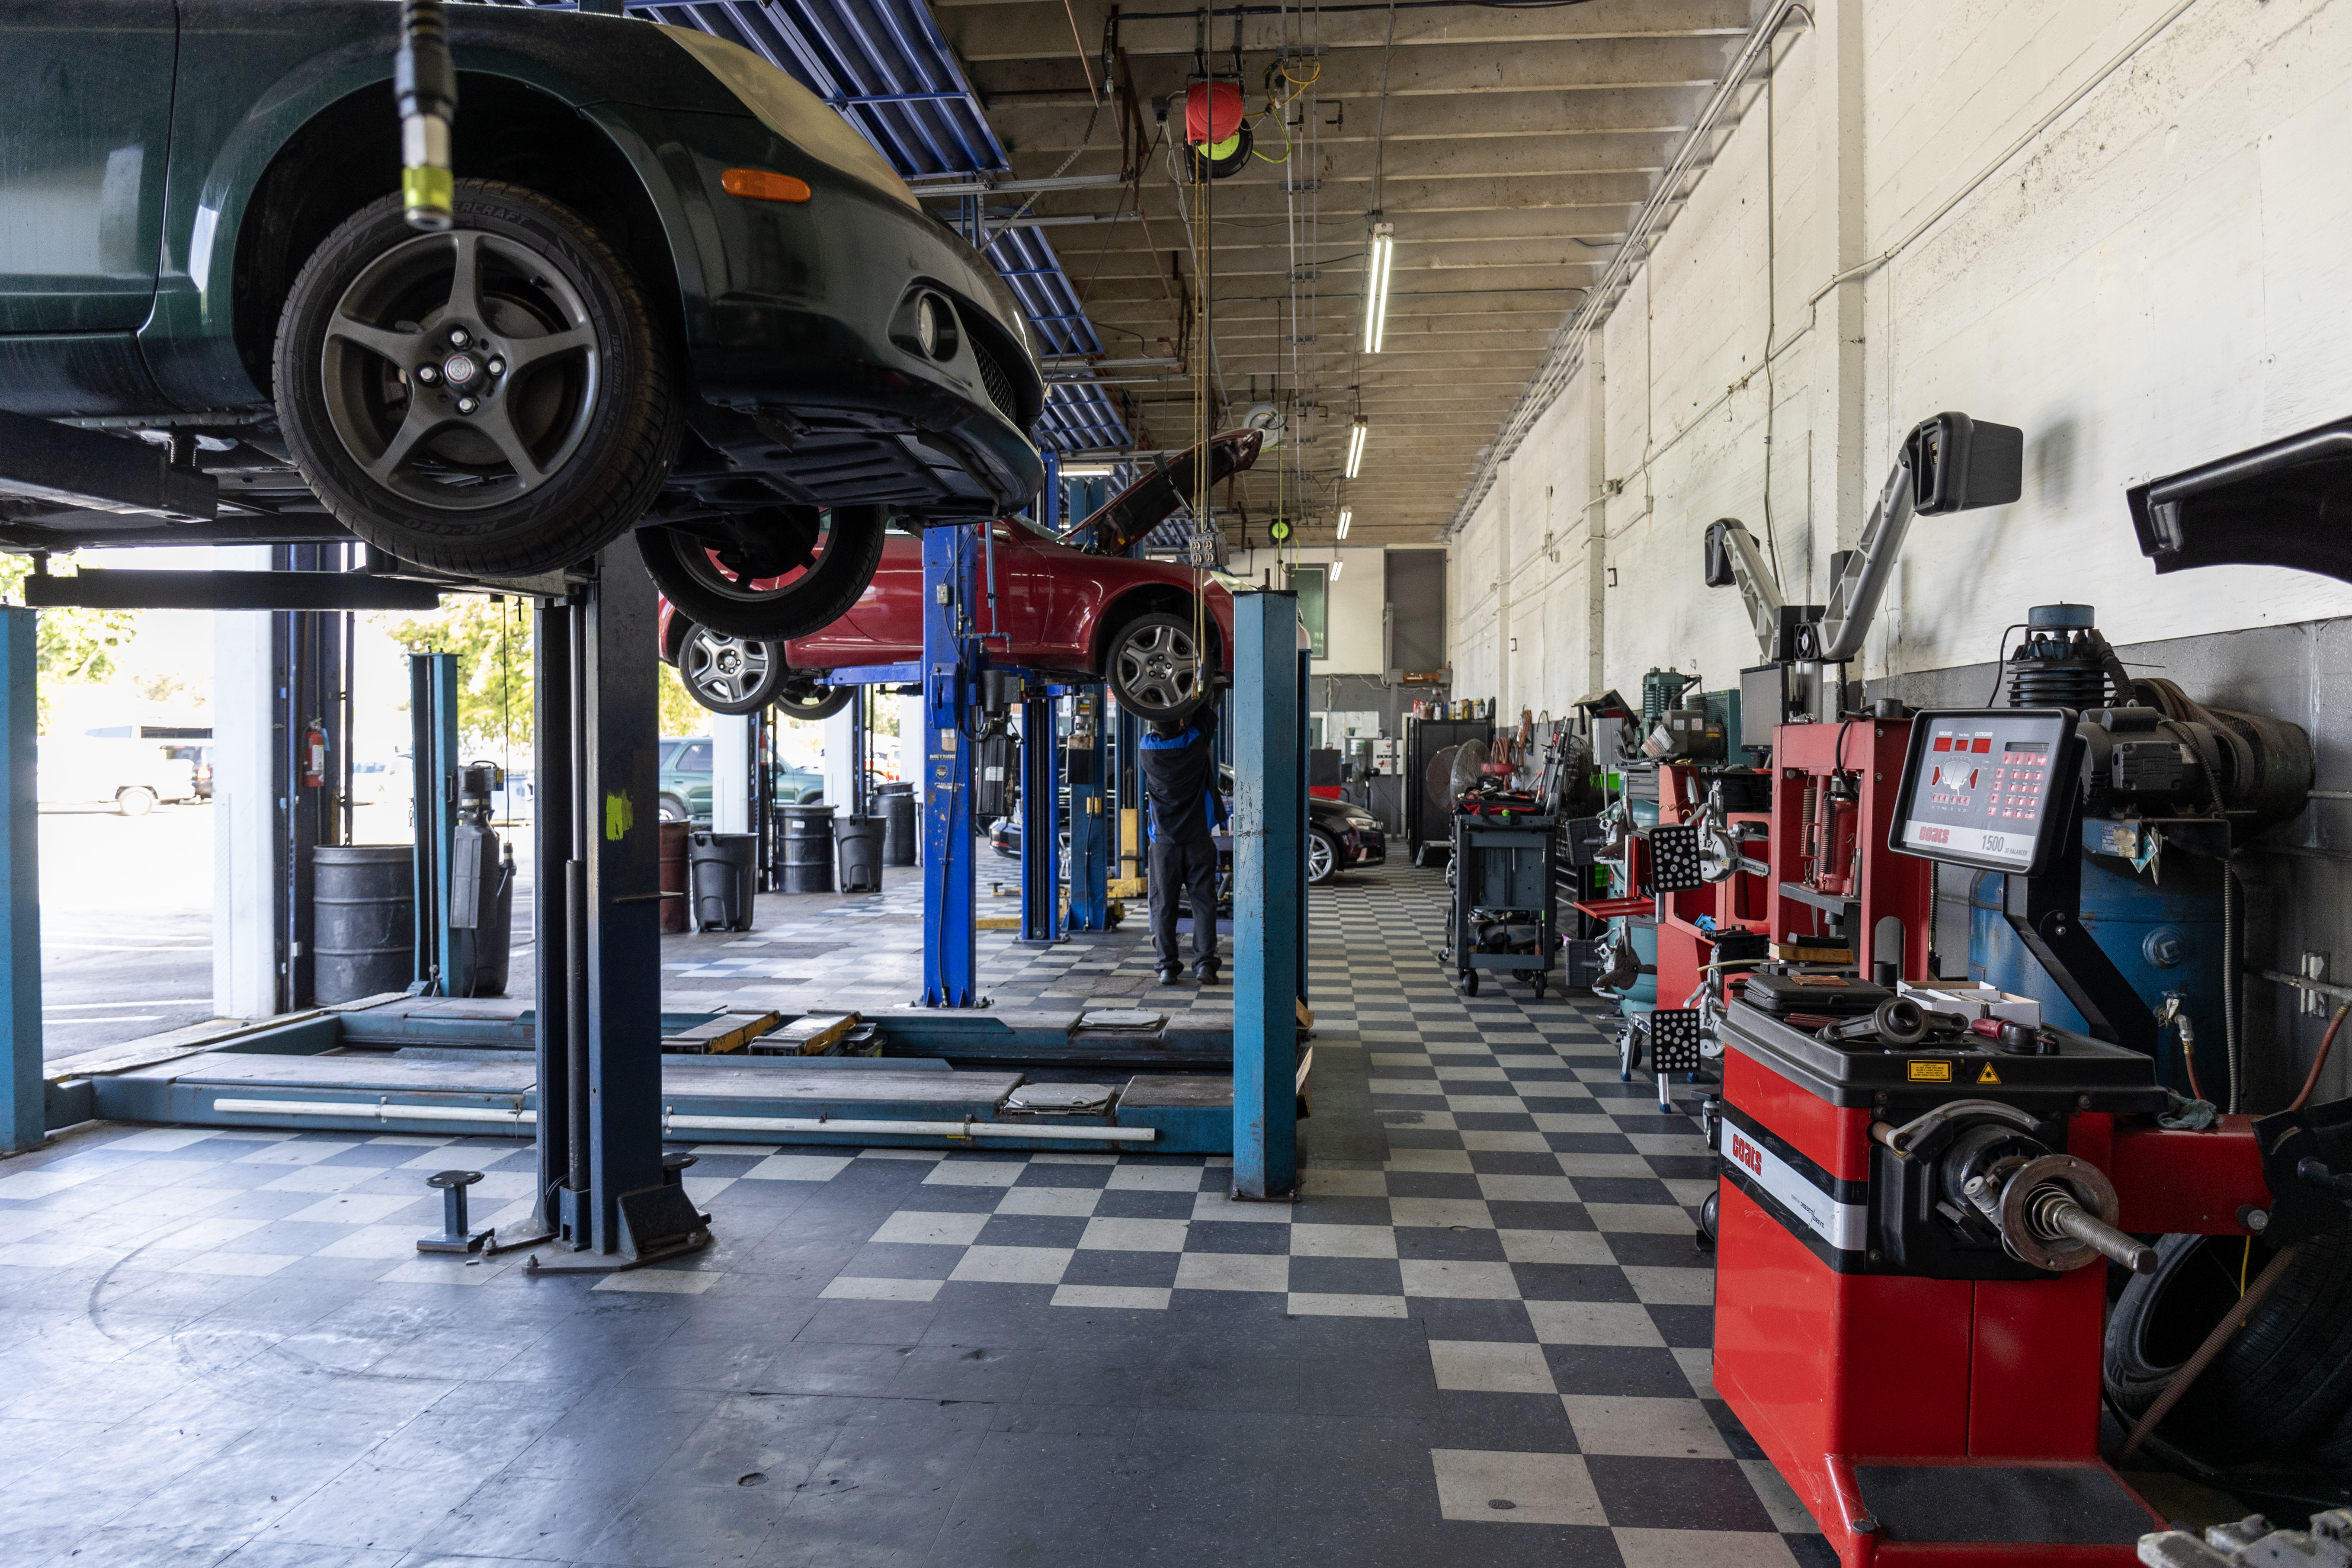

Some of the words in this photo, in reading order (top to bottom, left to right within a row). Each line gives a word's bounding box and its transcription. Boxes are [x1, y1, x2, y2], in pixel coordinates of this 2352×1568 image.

[453, 202, 529, 224] ERCRAFT
[1982, 834, 2004, 852] 1500
[1800, 1201, 1814, 1215] DIRECT
[1813, 1215, 1824, 1228] DRIVE
